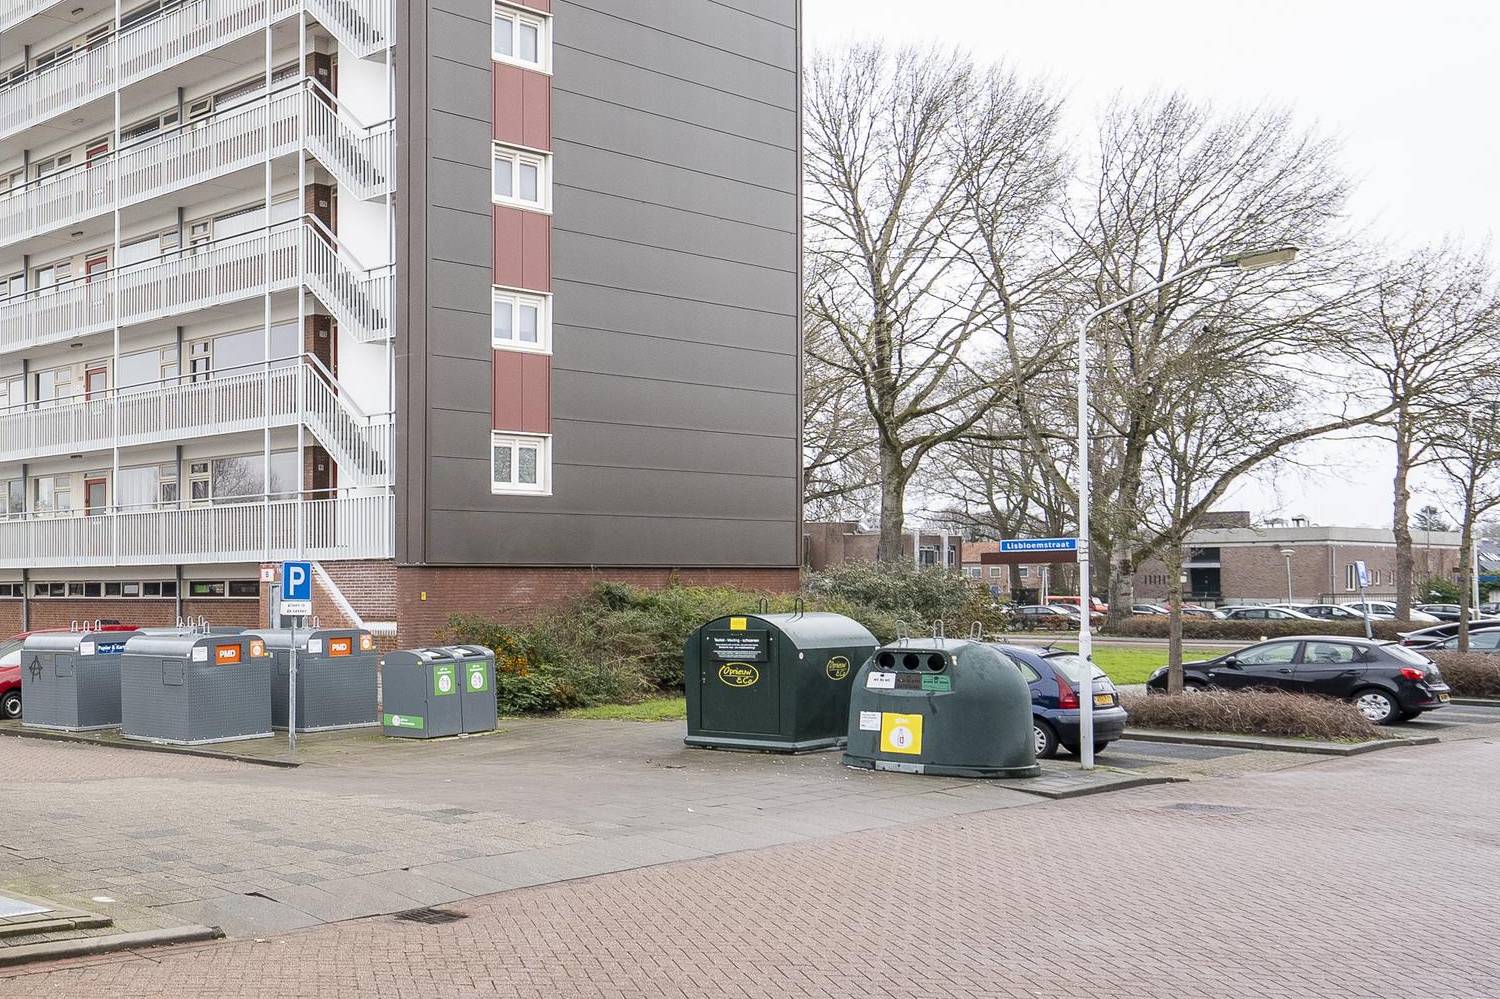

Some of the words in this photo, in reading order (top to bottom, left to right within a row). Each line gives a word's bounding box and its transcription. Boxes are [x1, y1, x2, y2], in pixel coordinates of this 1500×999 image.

[1006, 541, 1070, 549] Lisbloemstraat
[289, 566, 305, 596] P
[331, 643, 347, 651] PMD
[219, 649, 236, 658] PMD
[723, 666, 752, 676] Opnieuw
